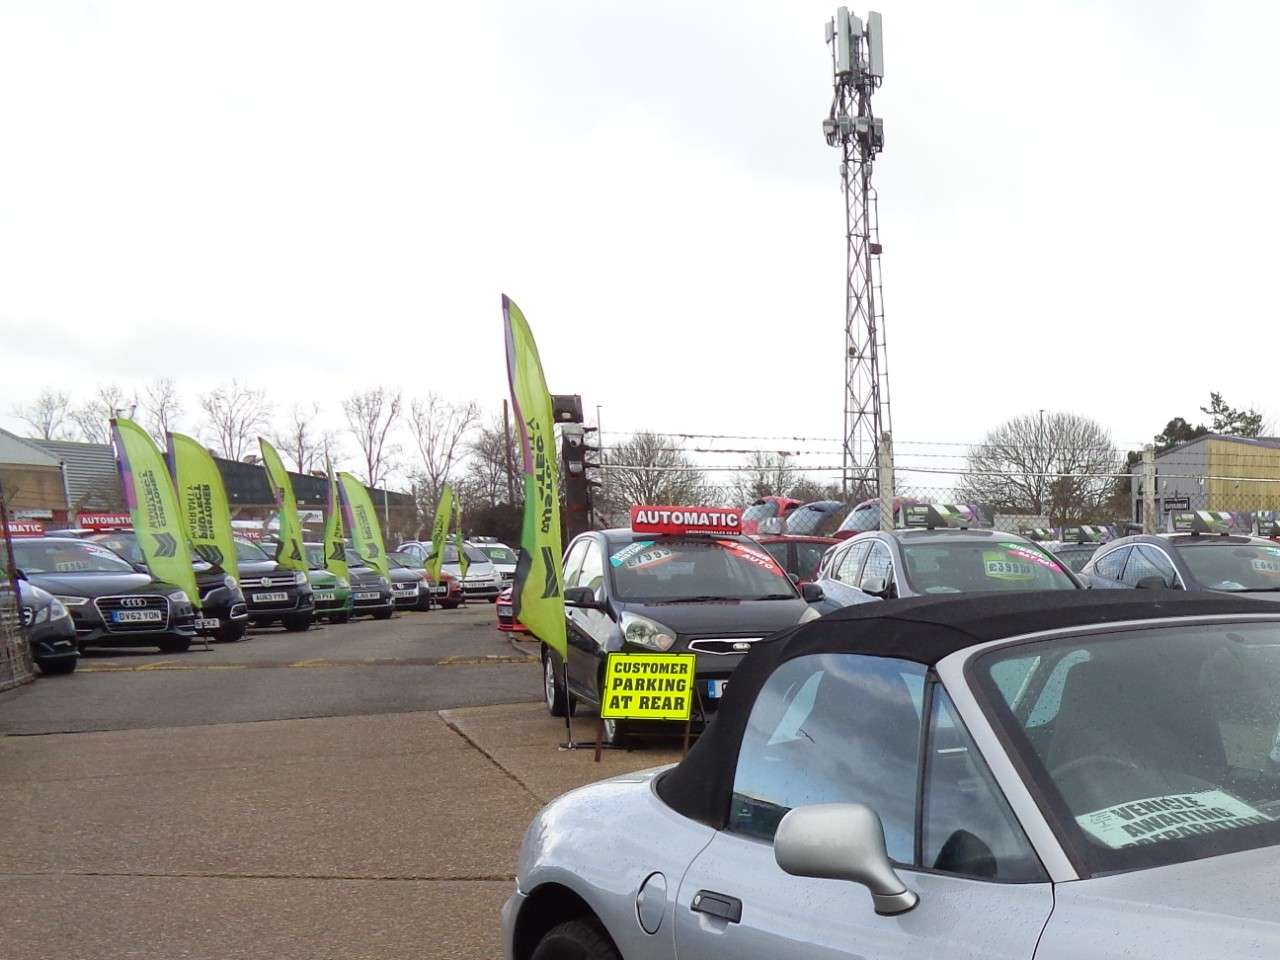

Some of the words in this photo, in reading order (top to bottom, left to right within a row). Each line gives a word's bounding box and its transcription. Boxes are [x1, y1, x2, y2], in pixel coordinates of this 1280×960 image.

[635, 510, 739, 527] AUTOMATIC
[614, 662, 688, 674] CUSTOMER
[612, 677, 687, 692] PARKING
[609, 695, 632, 709] AT
[639, 695, 685, 710] REAR
[1110, 796, 1206, 821] VEHICLE
[1120, 806, 1237, 838] AWAITING
